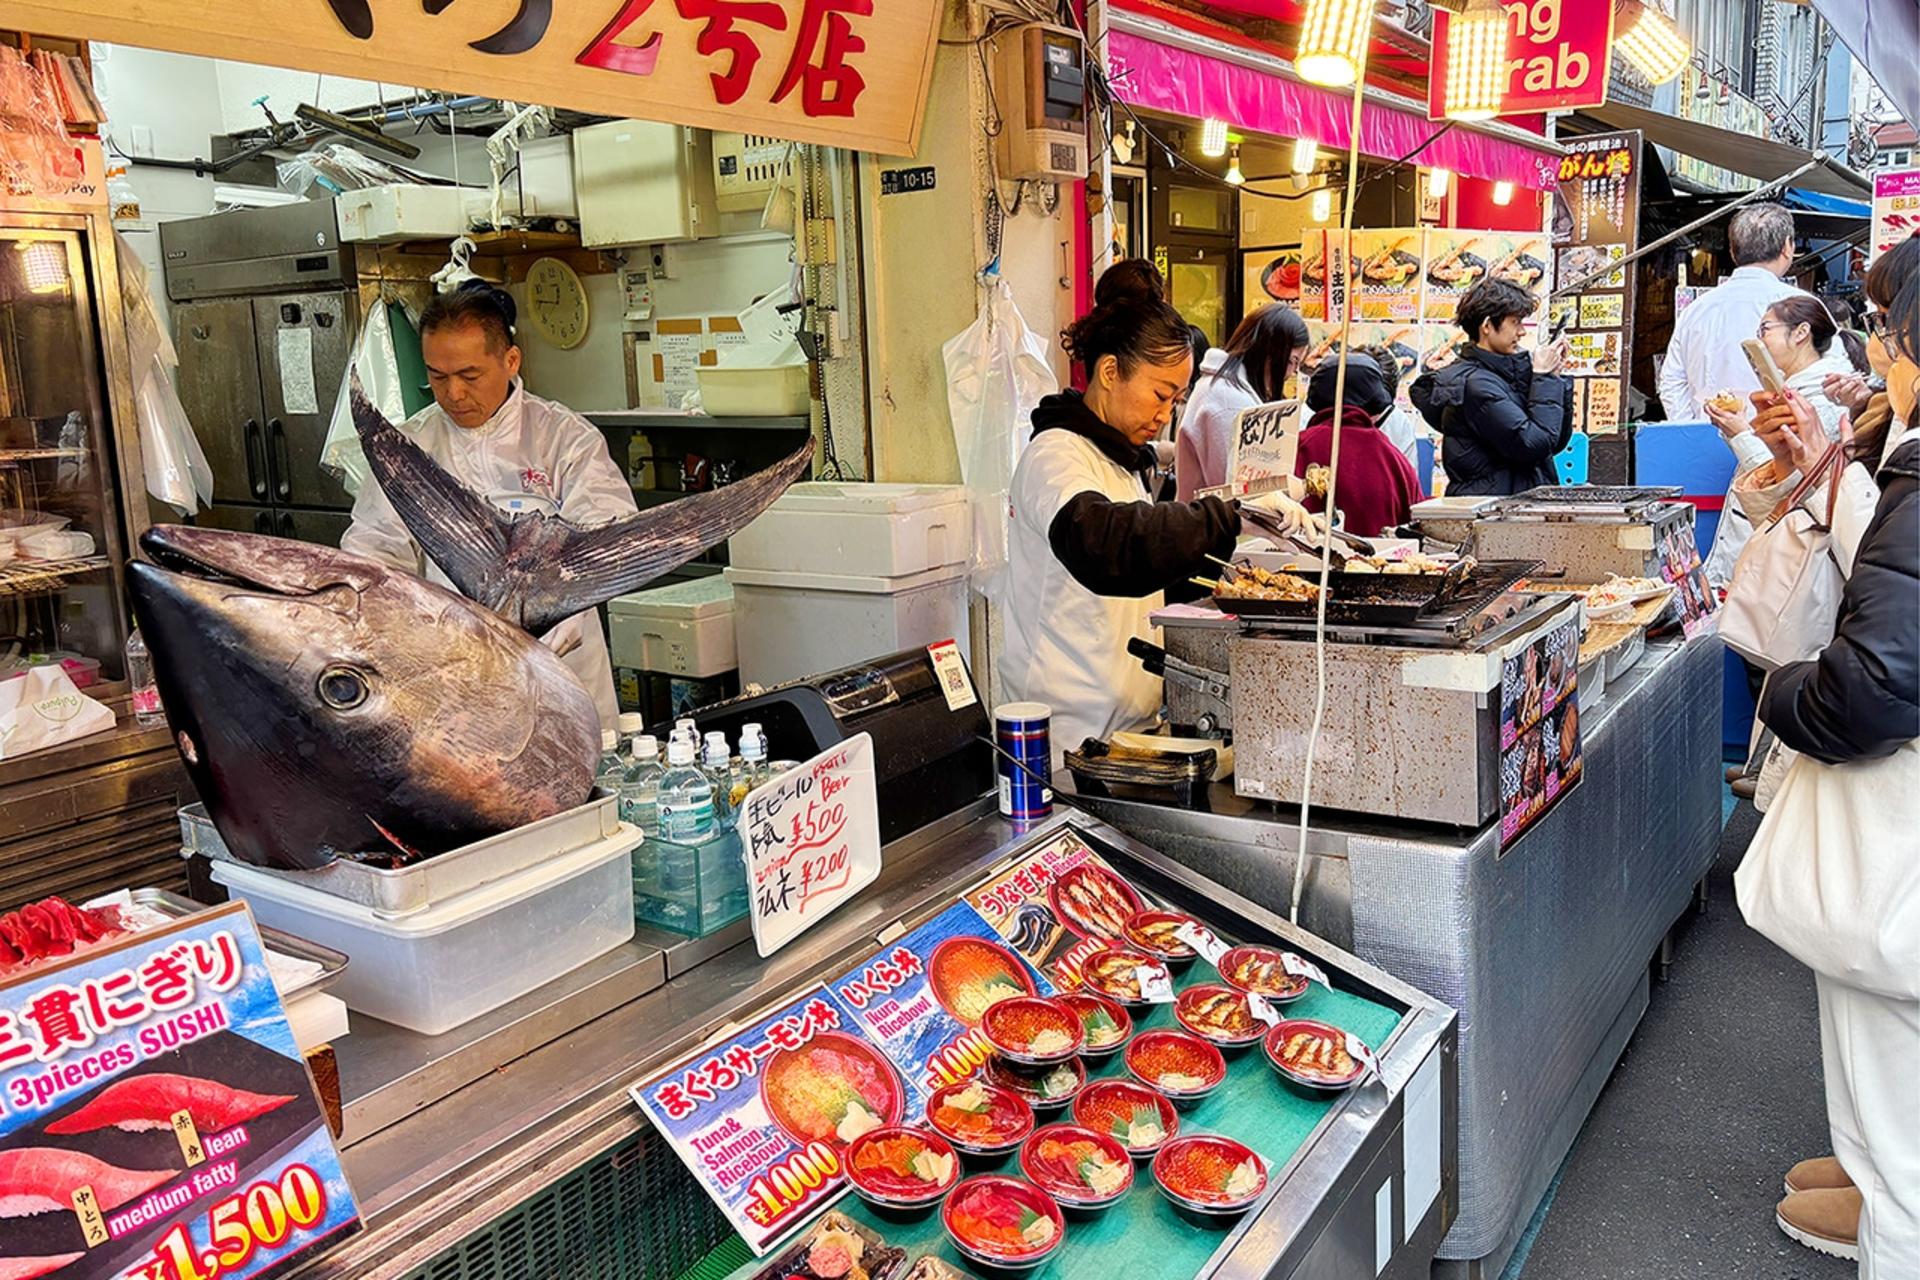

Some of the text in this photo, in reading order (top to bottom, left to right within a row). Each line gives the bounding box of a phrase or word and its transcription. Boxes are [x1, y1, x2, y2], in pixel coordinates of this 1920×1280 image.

[1500, 42, 1590, 94] rab
[904, 171, 934, 188] 10-15
[820, 775, 851, 802] Beer
[787, 800, 845, 849] ¥500
[797, 844, 849, 898] ¥200
[980, 862, 1052, 916] うなぎ丼
[841, 947, 924, 1008] いくら丼
[865, 999, 900, 1025] Ikura
[877, 995, 932, 1040] Ricebowl
[10, 1002, 228, 1109] 3pieces SUSHI
[655, 1002, 841, 1118] まぐろサーモン丼
[176, 1115, 200, 1159] 赤身
[206, 1126, 247, 1157] lean
[690, 1117, 742, 1154] Tuna&
[704, 1127, 762, 1170] Salmon
[717, 1134, 787, 1187] Ricebowl
[110, 1160, 238, 1237] medium fatty
[746, 1141, 839, 1225] ¥1,000
[76, 1190, 105, 1240] 中とろ
[128, 1164, 322, 1280] ¥1,500
